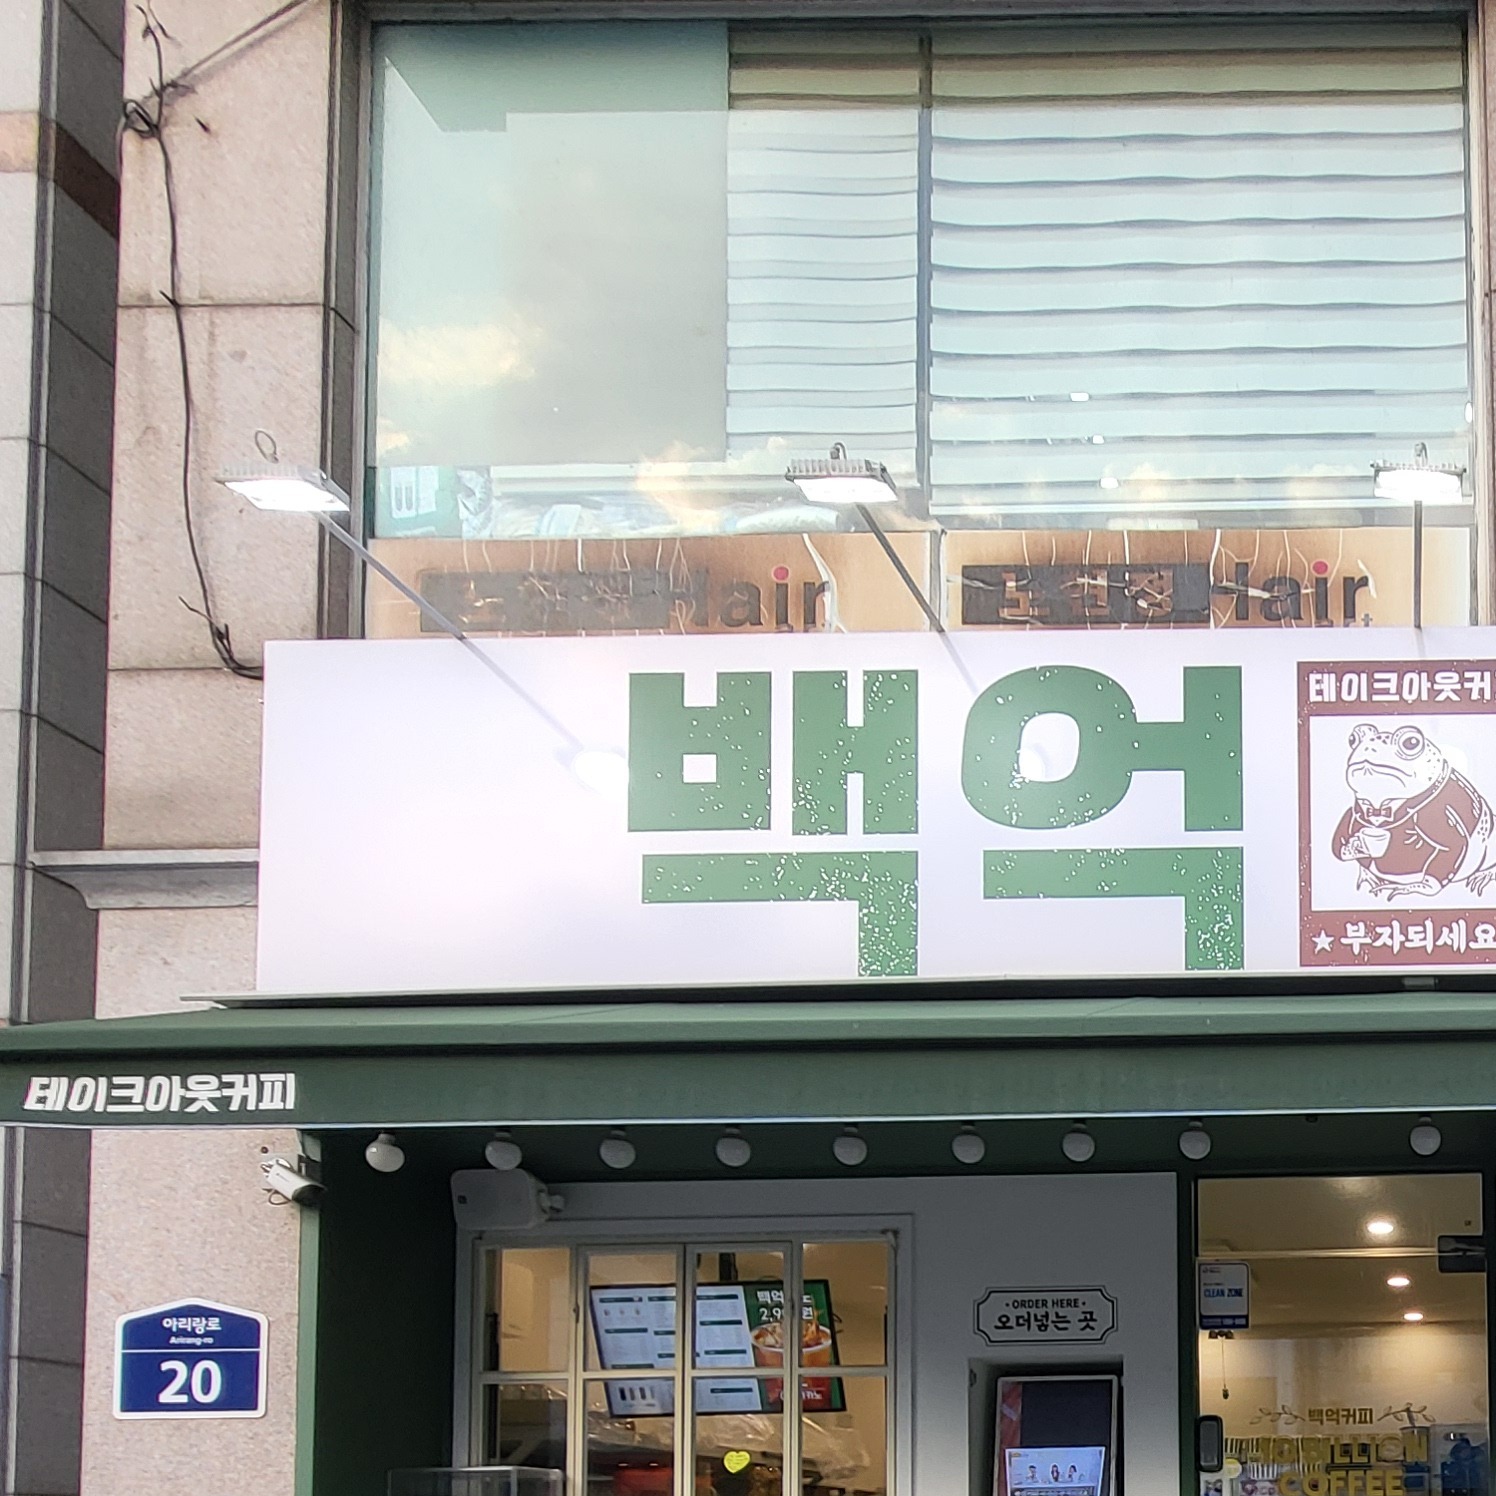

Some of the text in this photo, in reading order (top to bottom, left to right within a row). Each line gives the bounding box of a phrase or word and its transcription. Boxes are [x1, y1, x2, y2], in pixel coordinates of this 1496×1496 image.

[628, 665, 1243, 976] 백억
[23, 1072, 296, 1113] 테이크아웃커피
[1012, 1298, 1080, 1309] ORDER HERE
[162, 1316, 222, 1334] 아리랑로
[994, 1310, 1098, 1332] 오더넣는 곳
[158, 1359, 222, 1404] 20
[1308, 1408, 1373, 1425] 백억커피
